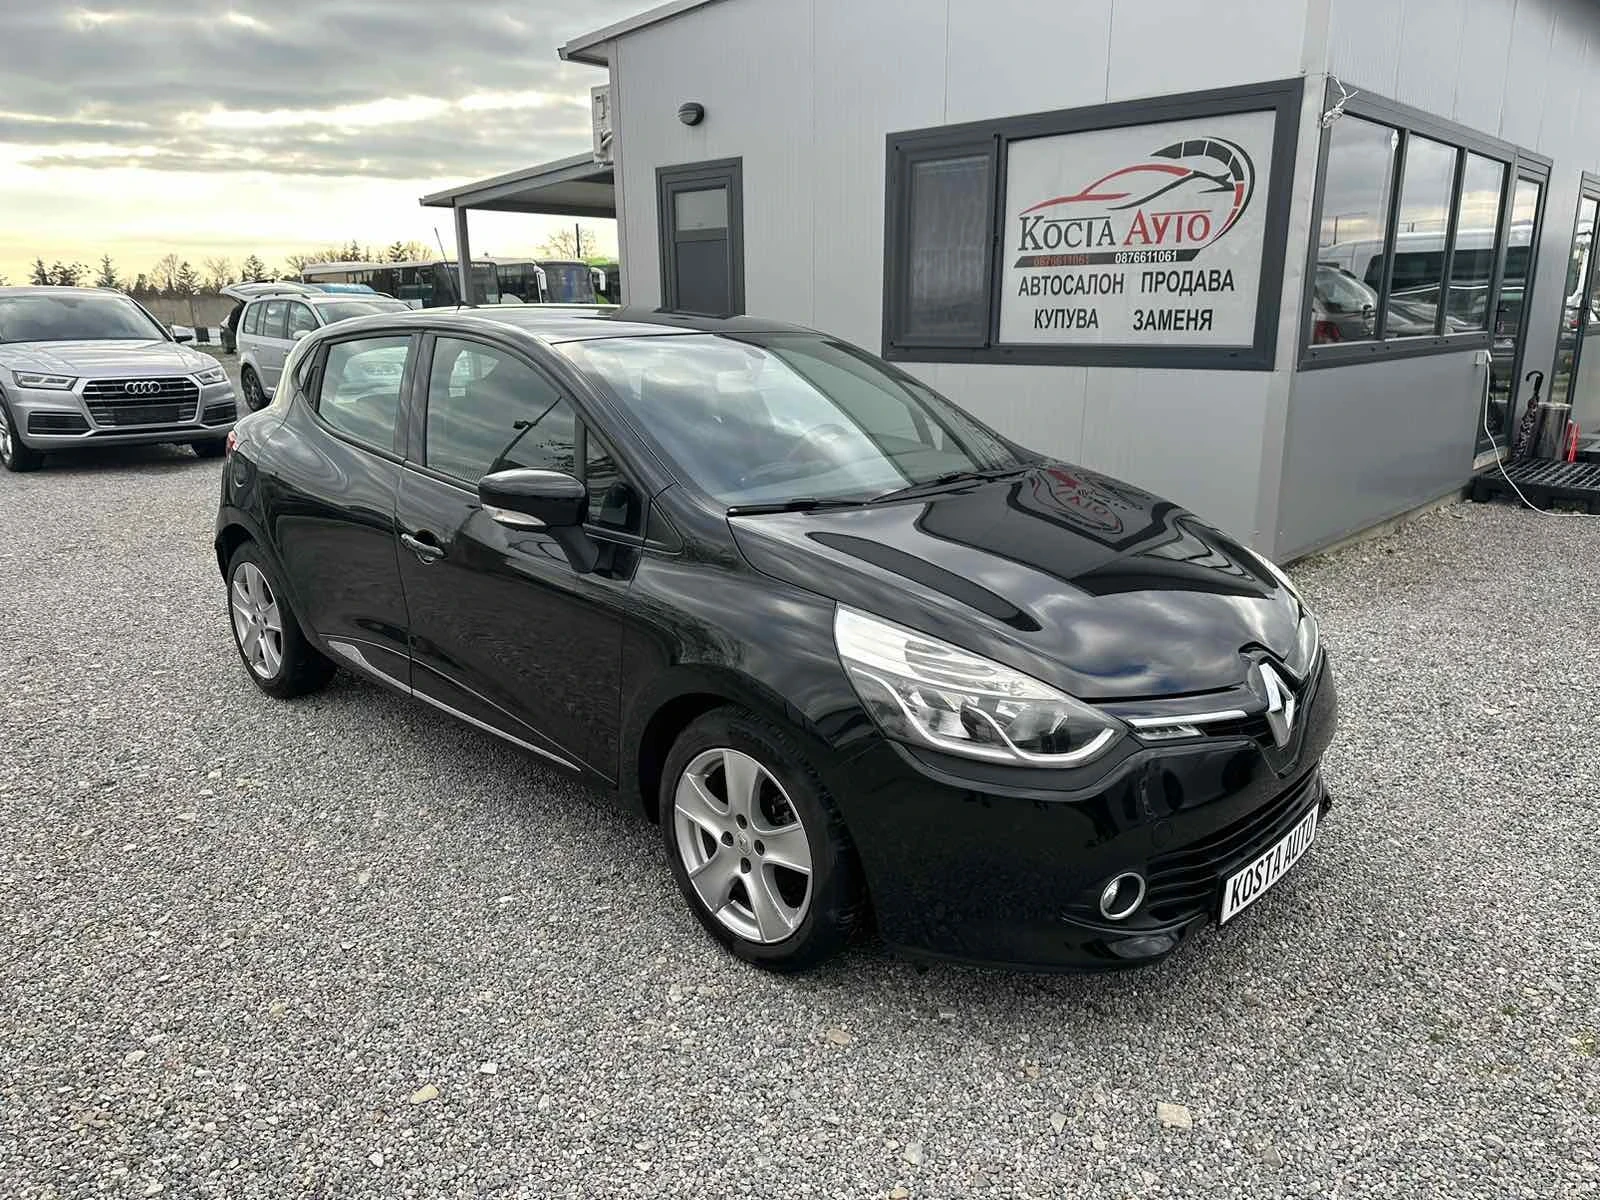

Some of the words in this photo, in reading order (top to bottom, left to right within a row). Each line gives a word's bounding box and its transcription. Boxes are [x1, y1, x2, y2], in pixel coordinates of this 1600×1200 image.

[1114, 250, 1178, 264] 0876611061
[1018, 273, 1125, 296] АВТОСАЛОН
[1140, 269, 1235, 296] ПРОДАВА
[1034, 308, 1099, 329] КУПУВА
[1133, 308, 1214, 331] ЗАМЕНЯ
[1229, 844, 1282, 913] KOSTA
[1283, 812, 1315, 870] AUTO
